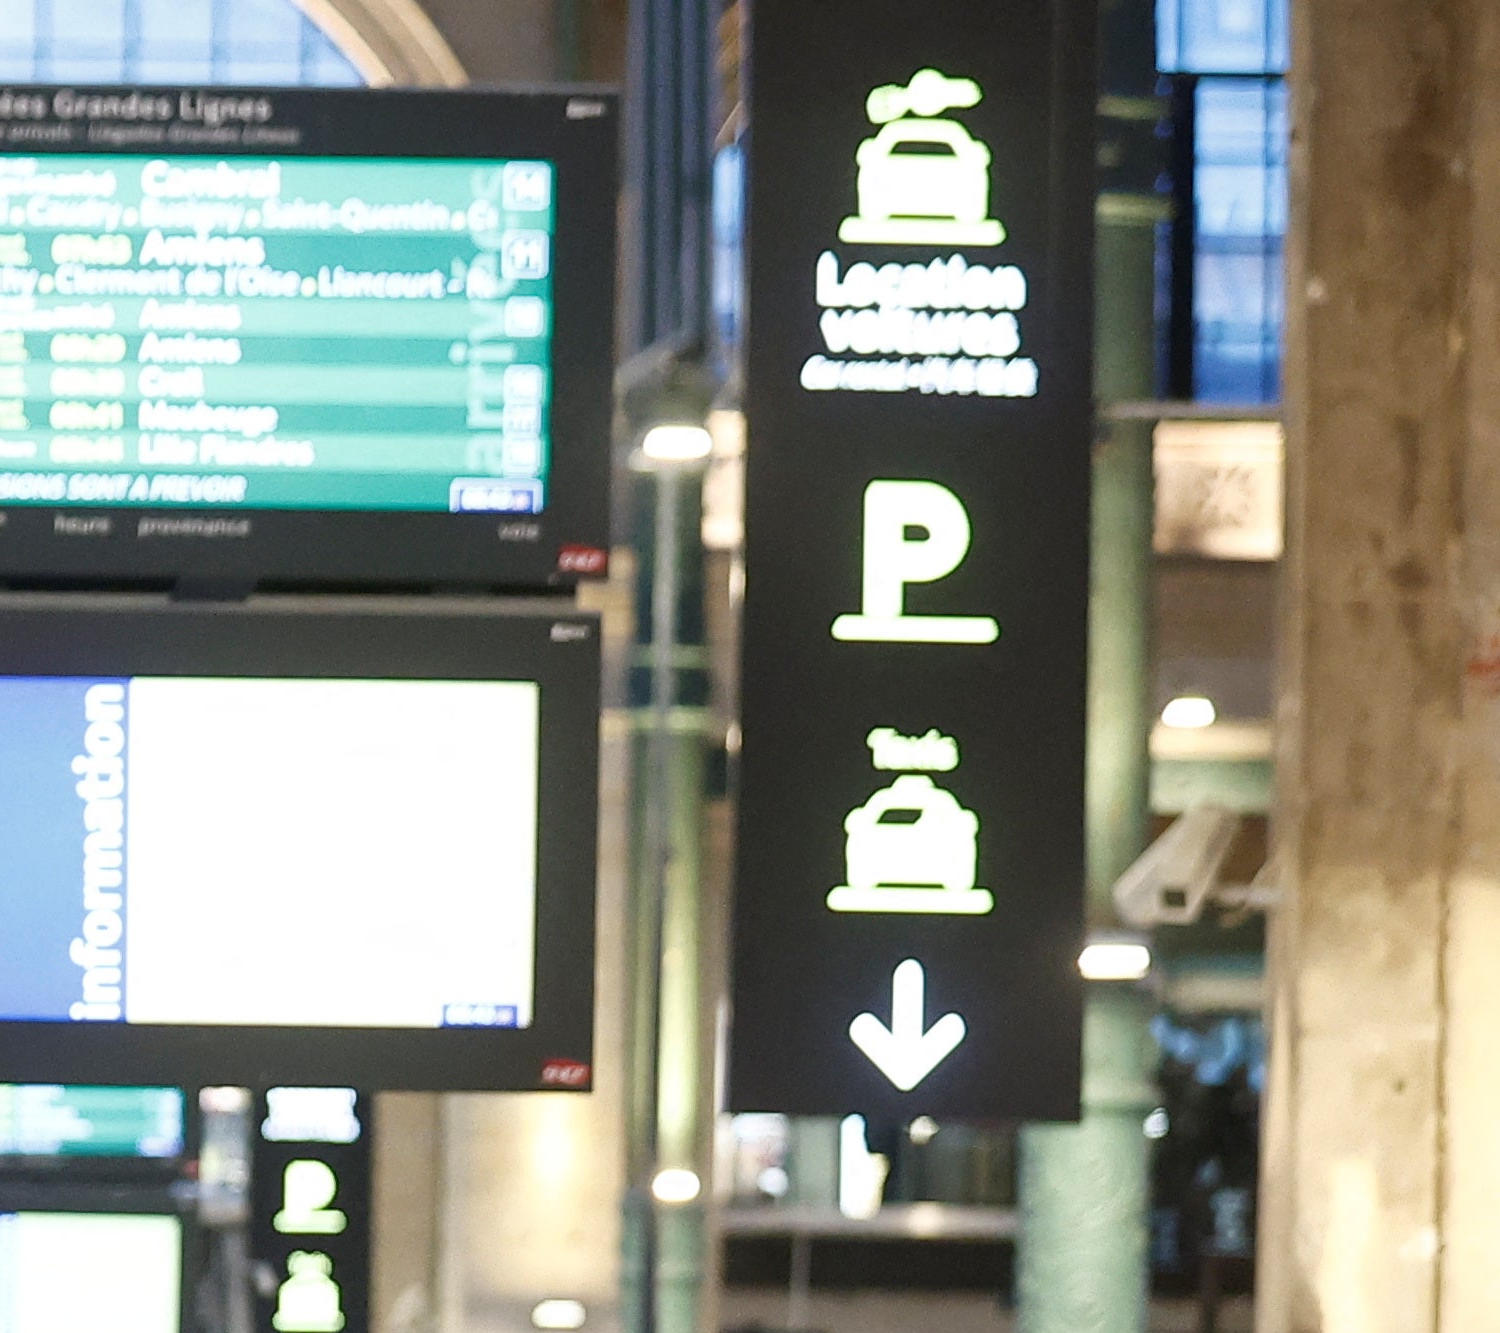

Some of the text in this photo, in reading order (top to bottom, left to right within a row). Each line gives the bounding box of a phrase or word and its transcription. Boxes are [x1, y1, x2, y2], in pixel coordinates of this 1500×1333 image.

[54, 88, 174, 120] Grandes
[179, 91, 273, 126] Lignes
[863, 479, 972, 616] P
[70, 685, 124, 1021] information
